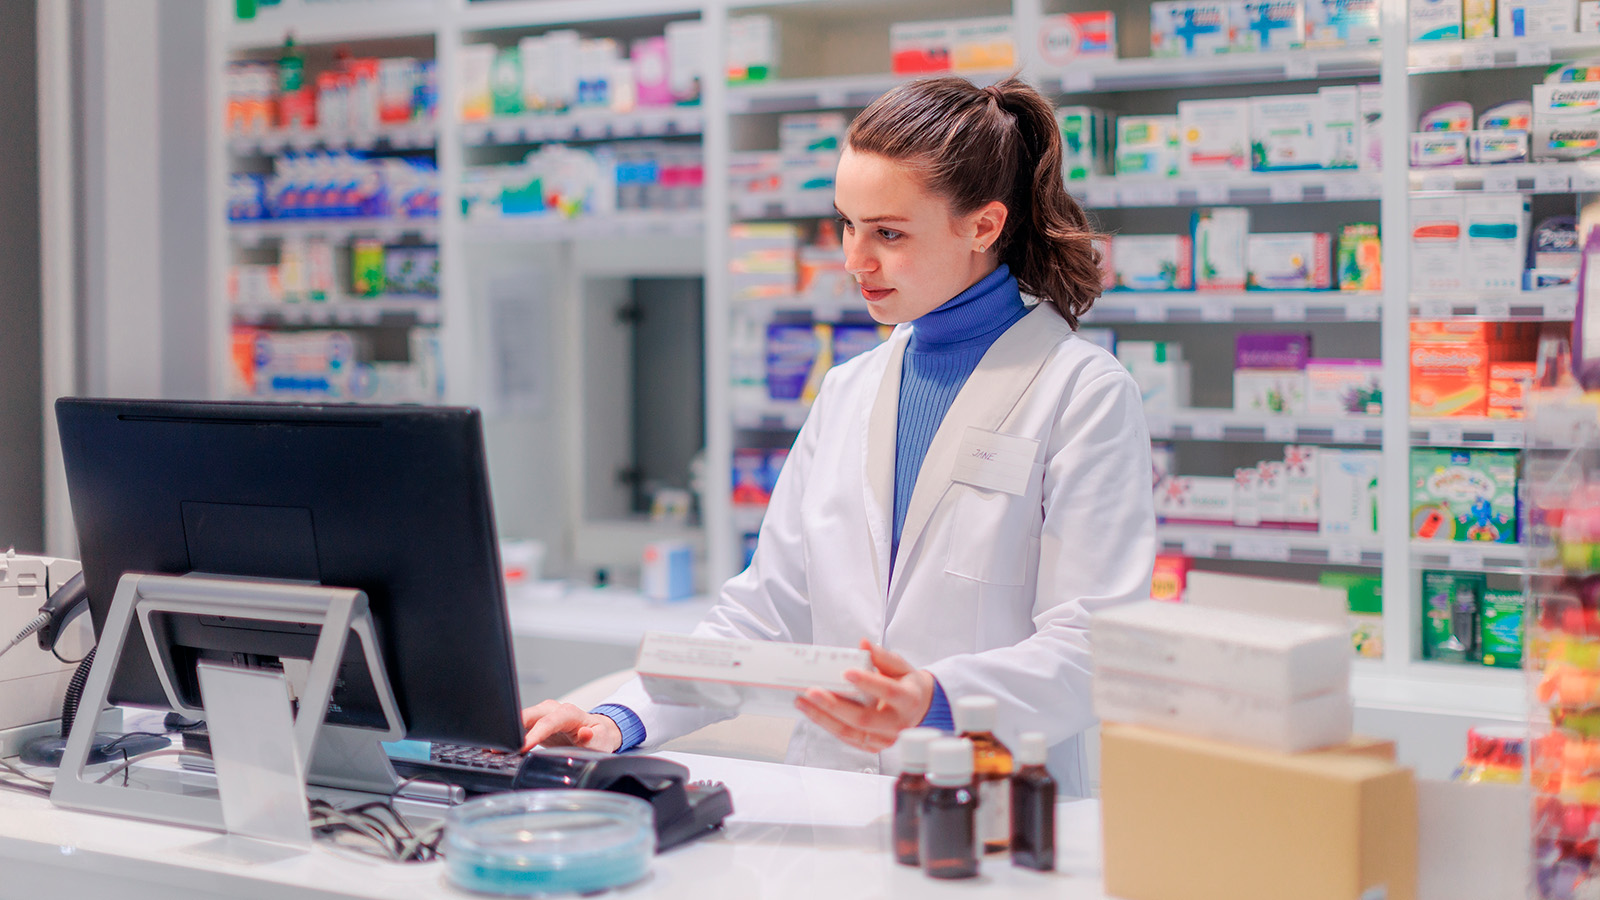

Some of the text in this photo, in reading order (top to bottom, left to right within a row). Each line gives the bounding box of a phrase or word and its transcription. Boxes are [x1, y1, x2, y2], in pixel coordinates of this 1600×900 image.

[1551, 89, 1600, 101] Centrum
[1549, 128, 1599, 140] Centrum
[971, 448, 997, 461] JANE
